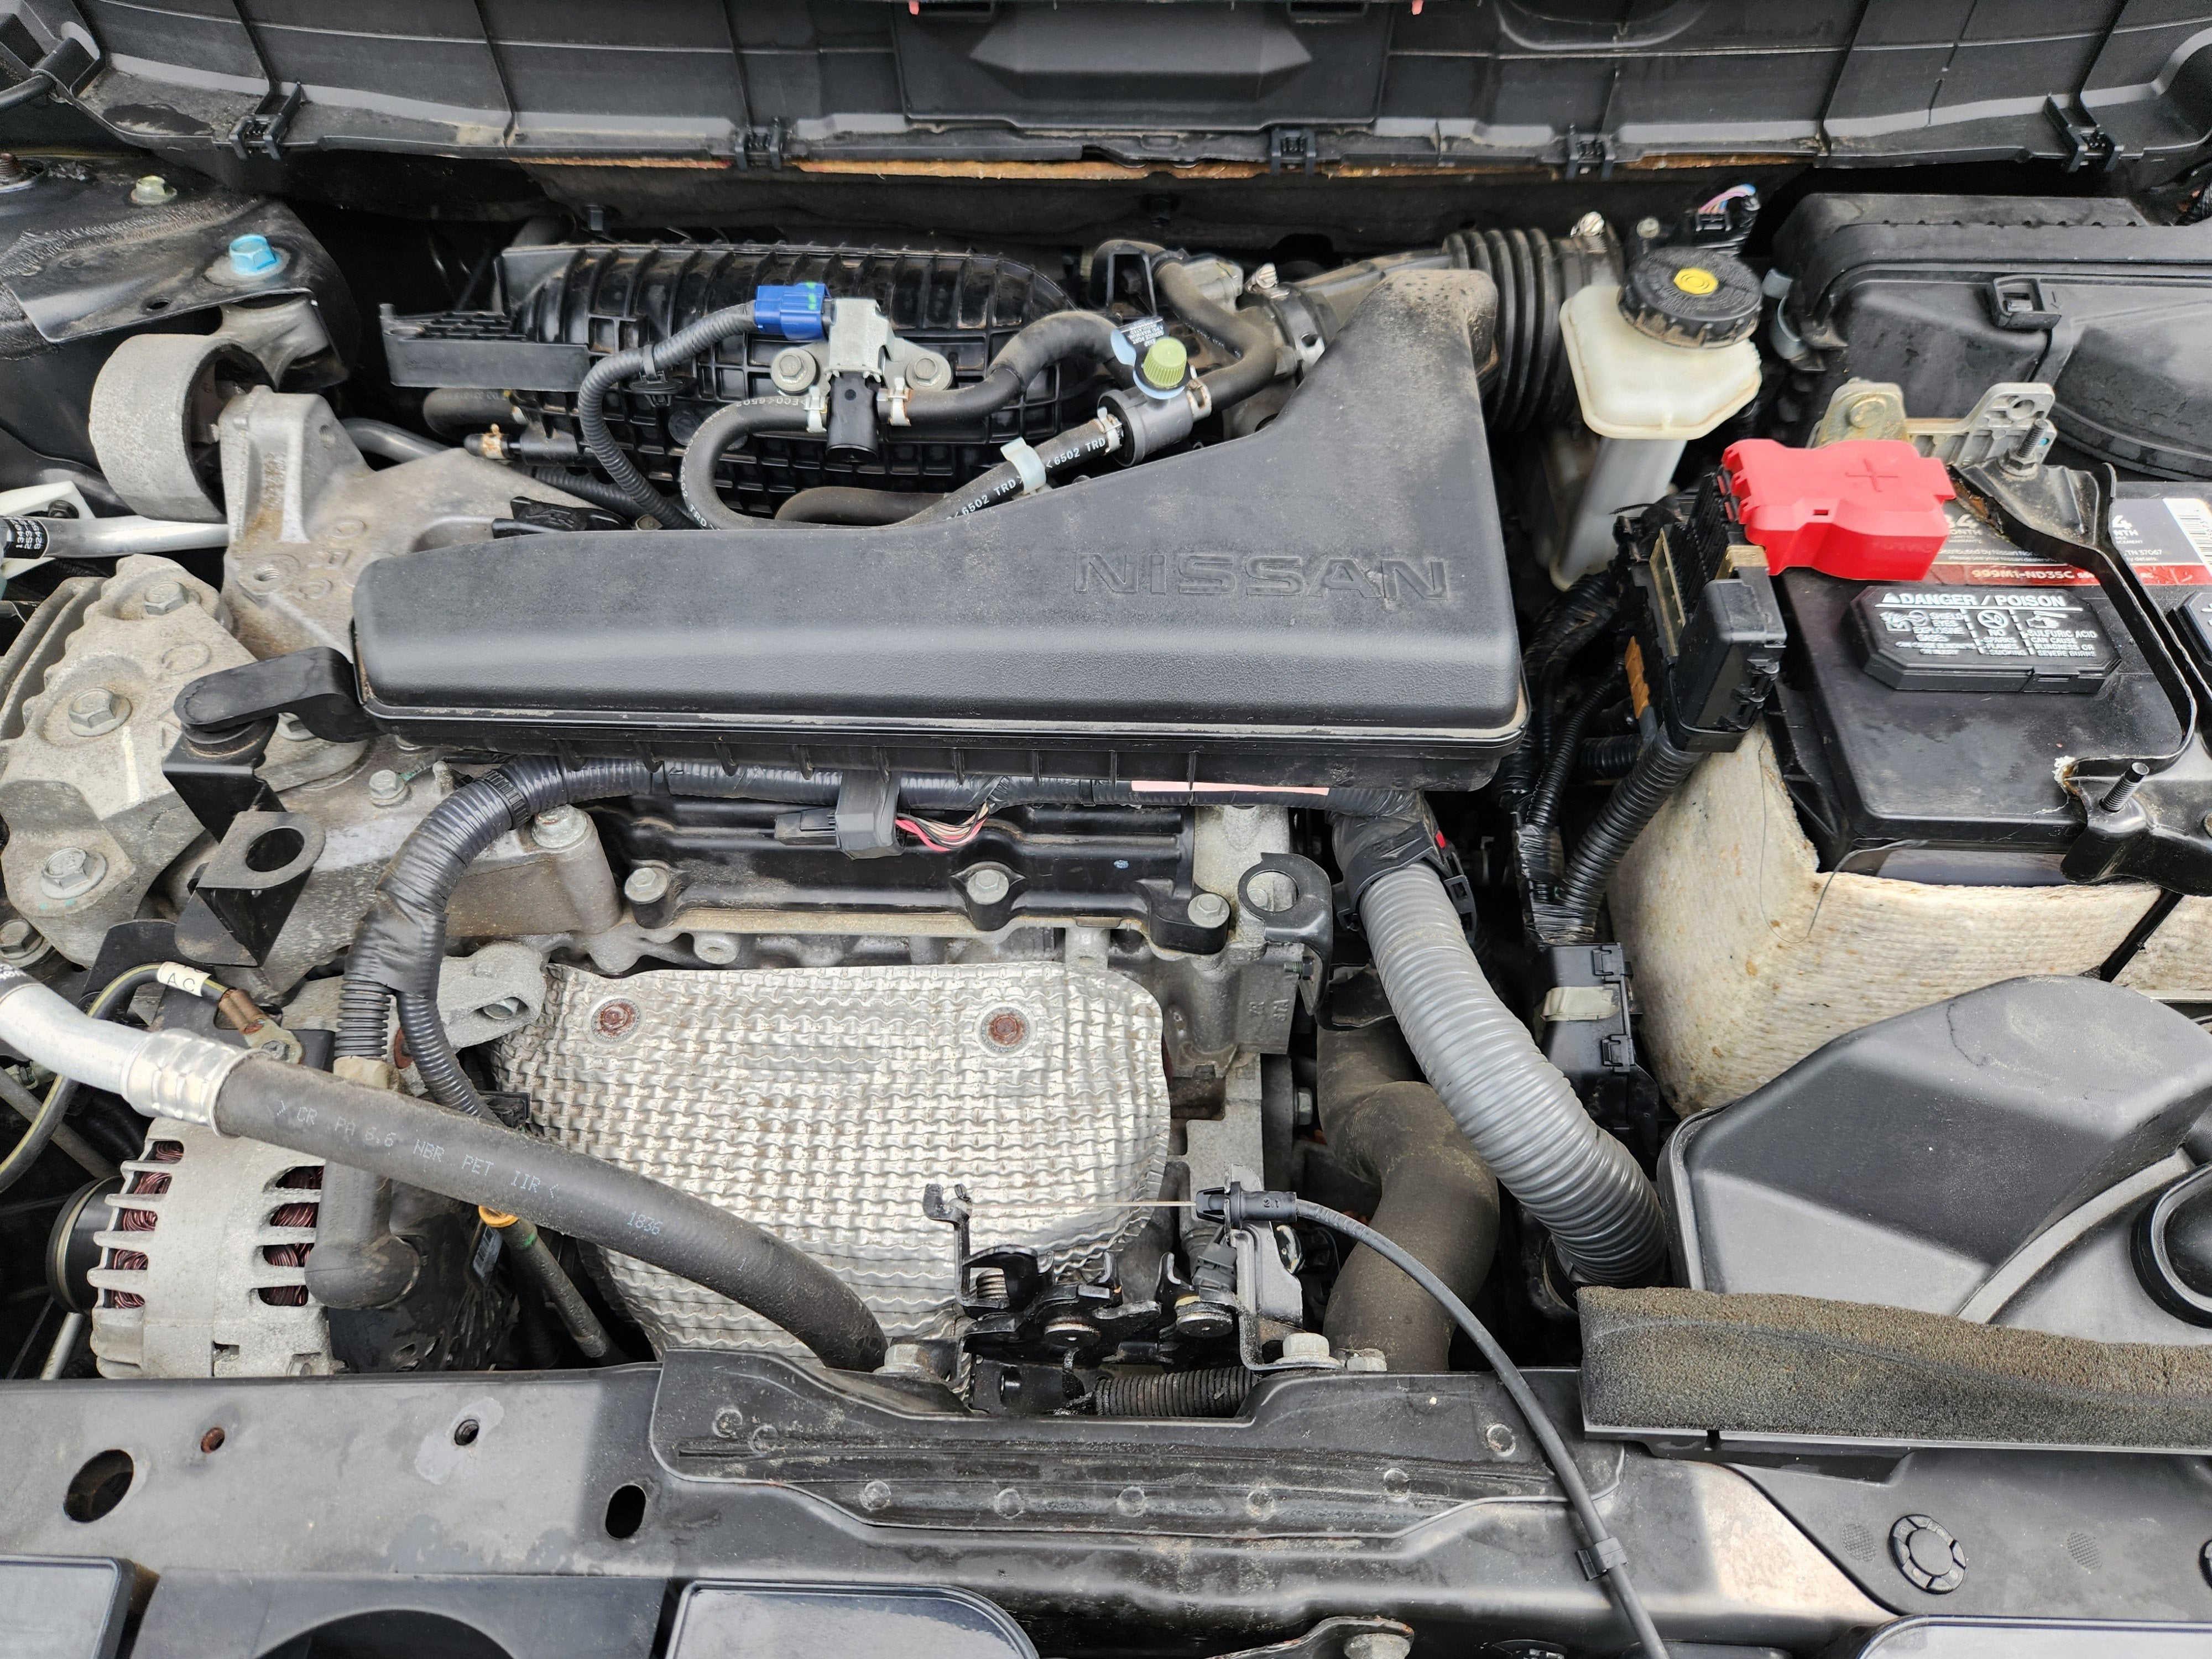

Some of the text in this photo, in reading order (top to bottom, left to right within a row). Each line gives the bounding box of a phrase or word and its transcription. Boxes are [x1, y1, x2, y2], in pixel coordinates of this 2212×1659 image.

[1074, 552, 1450, 601] NISSAN
[1971, 570, 2074, 579] 999M1-ND35C
[1899, 593, 1978, 606] DANGER
[1994, 594, 2066, 607] POISON
[2074, 630, 2098, 639] ACID
[412, 1139, 445, 1162] NBR
[462, 1154, 494, 1177] PET
[1263, 1197, 1280, 1209] 2.1
[625, 1210, 661, 1236] 1836
